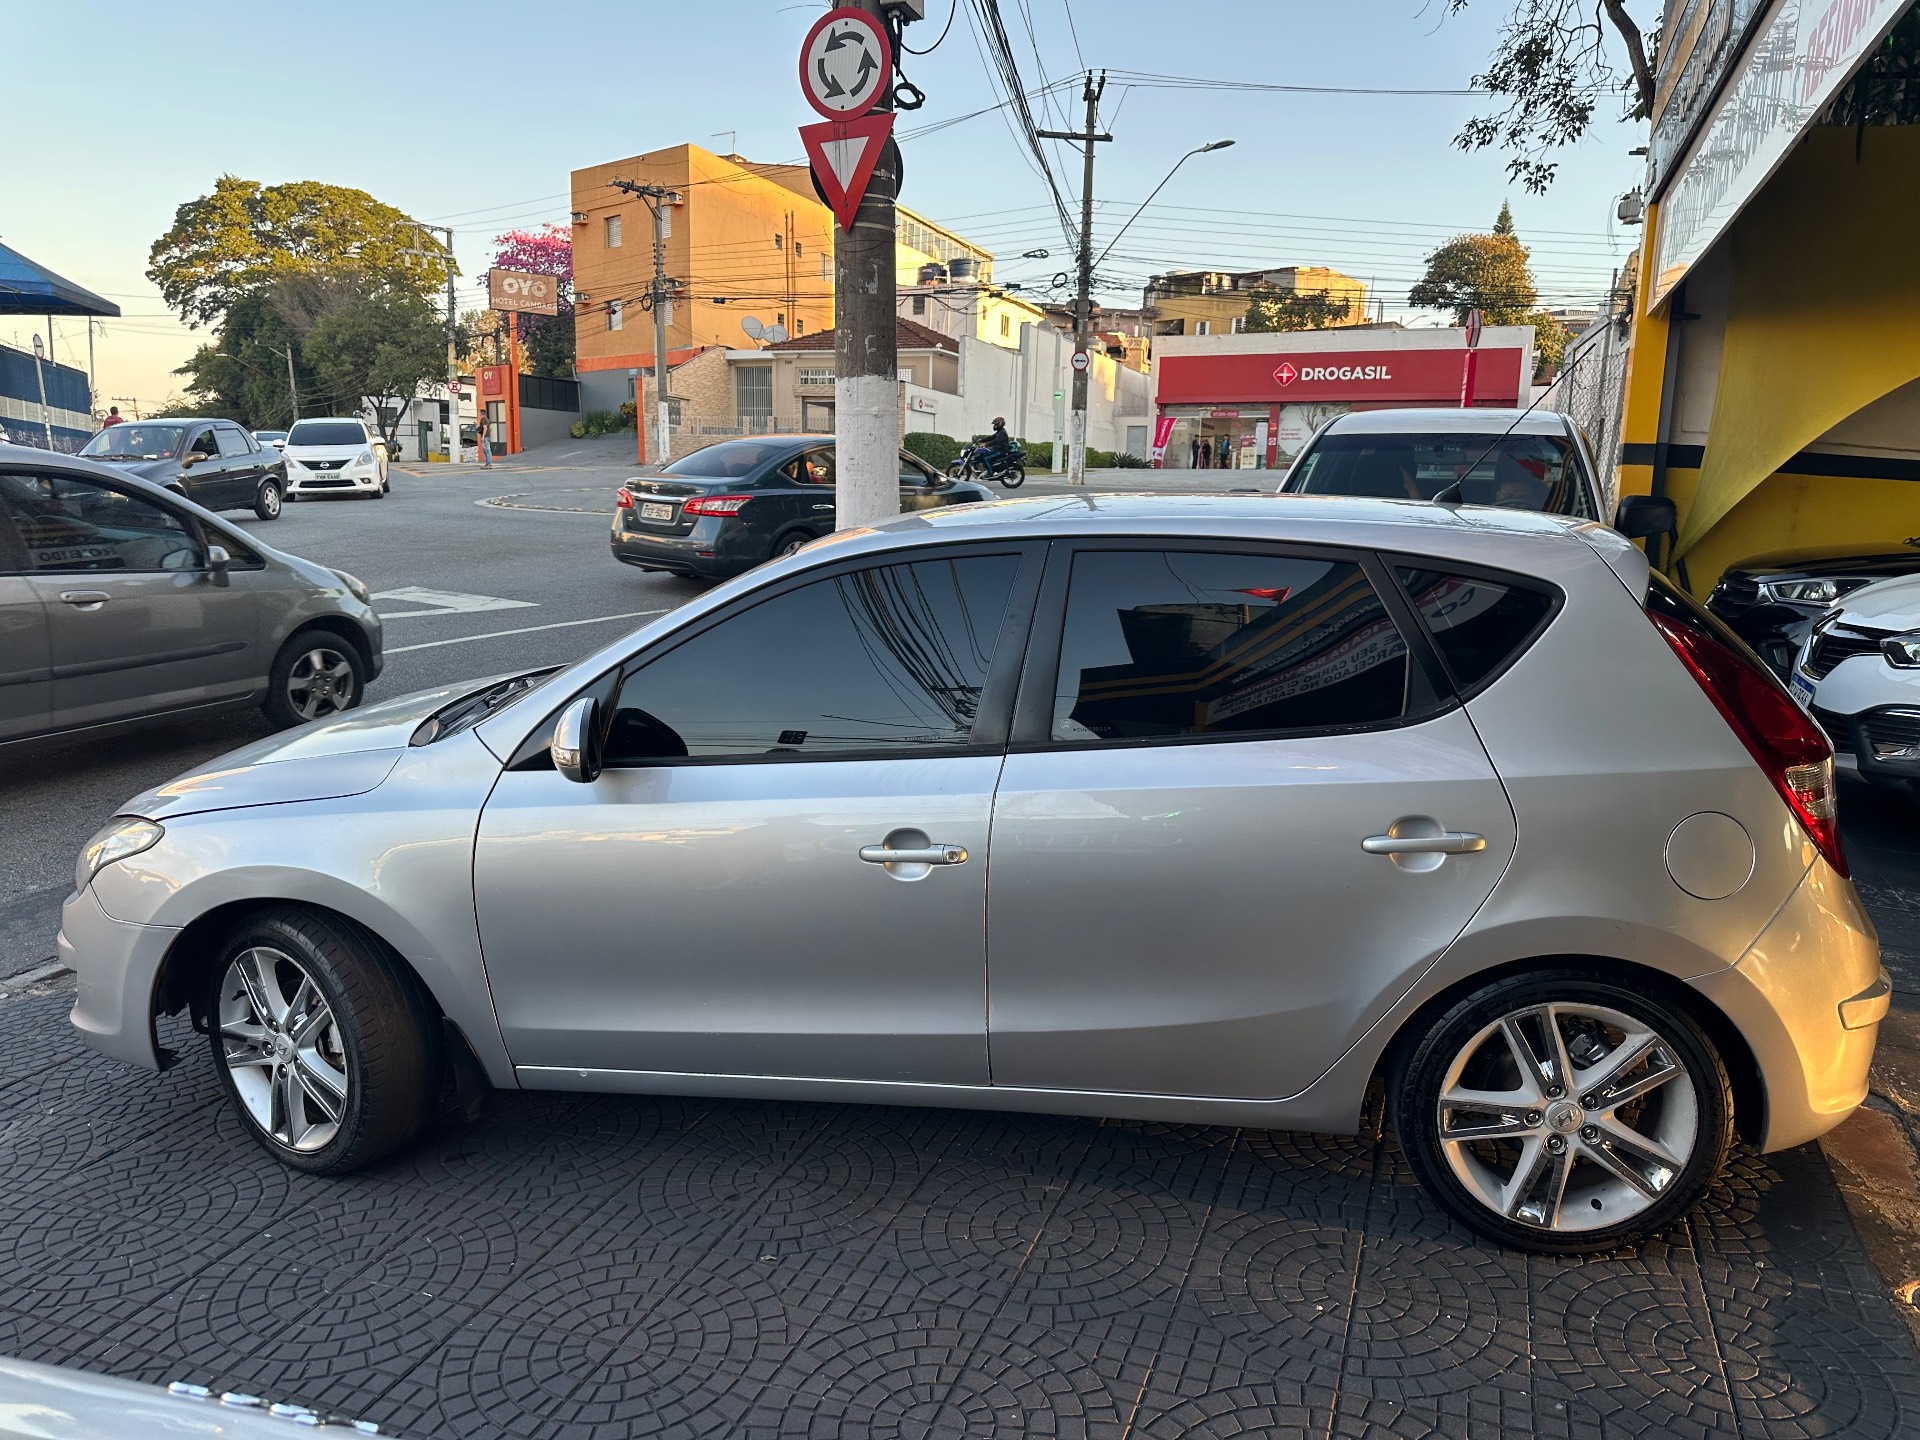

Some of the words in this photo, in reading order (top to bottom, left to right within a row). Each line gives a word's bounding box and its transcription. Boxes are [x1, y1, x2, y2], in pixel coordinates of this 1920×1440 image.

[502, 277, 547, 297] OYO
[492, 296, 518, 307] HOTEL
[1301, 366, 1392, 381] DROGASIL
